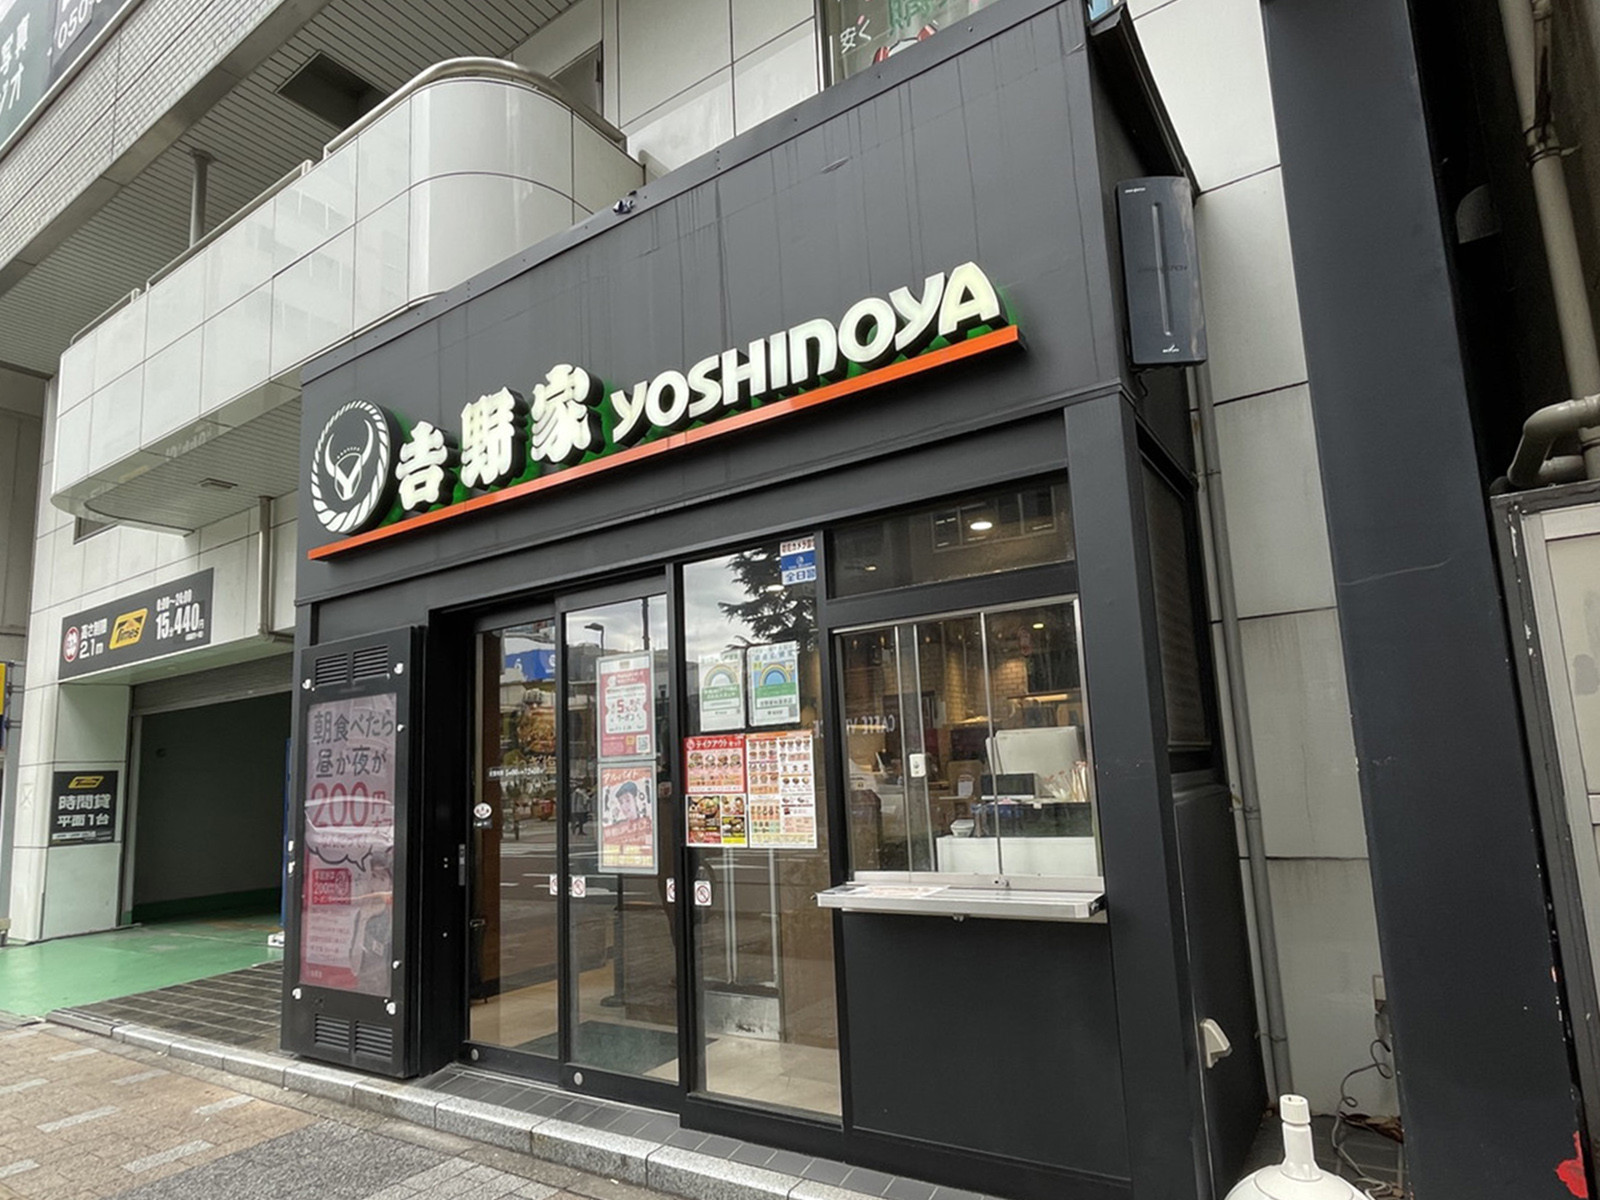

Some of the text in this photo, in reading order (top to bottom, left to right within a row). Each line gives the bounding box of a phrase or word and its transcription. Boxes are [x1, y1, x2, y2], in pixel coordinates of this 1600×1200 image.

[312, 709, 395, 746] 朝食べたら
[315, 745, 387, 778] 昼か夜が
[58, 793, 112, 811] 時間貸
